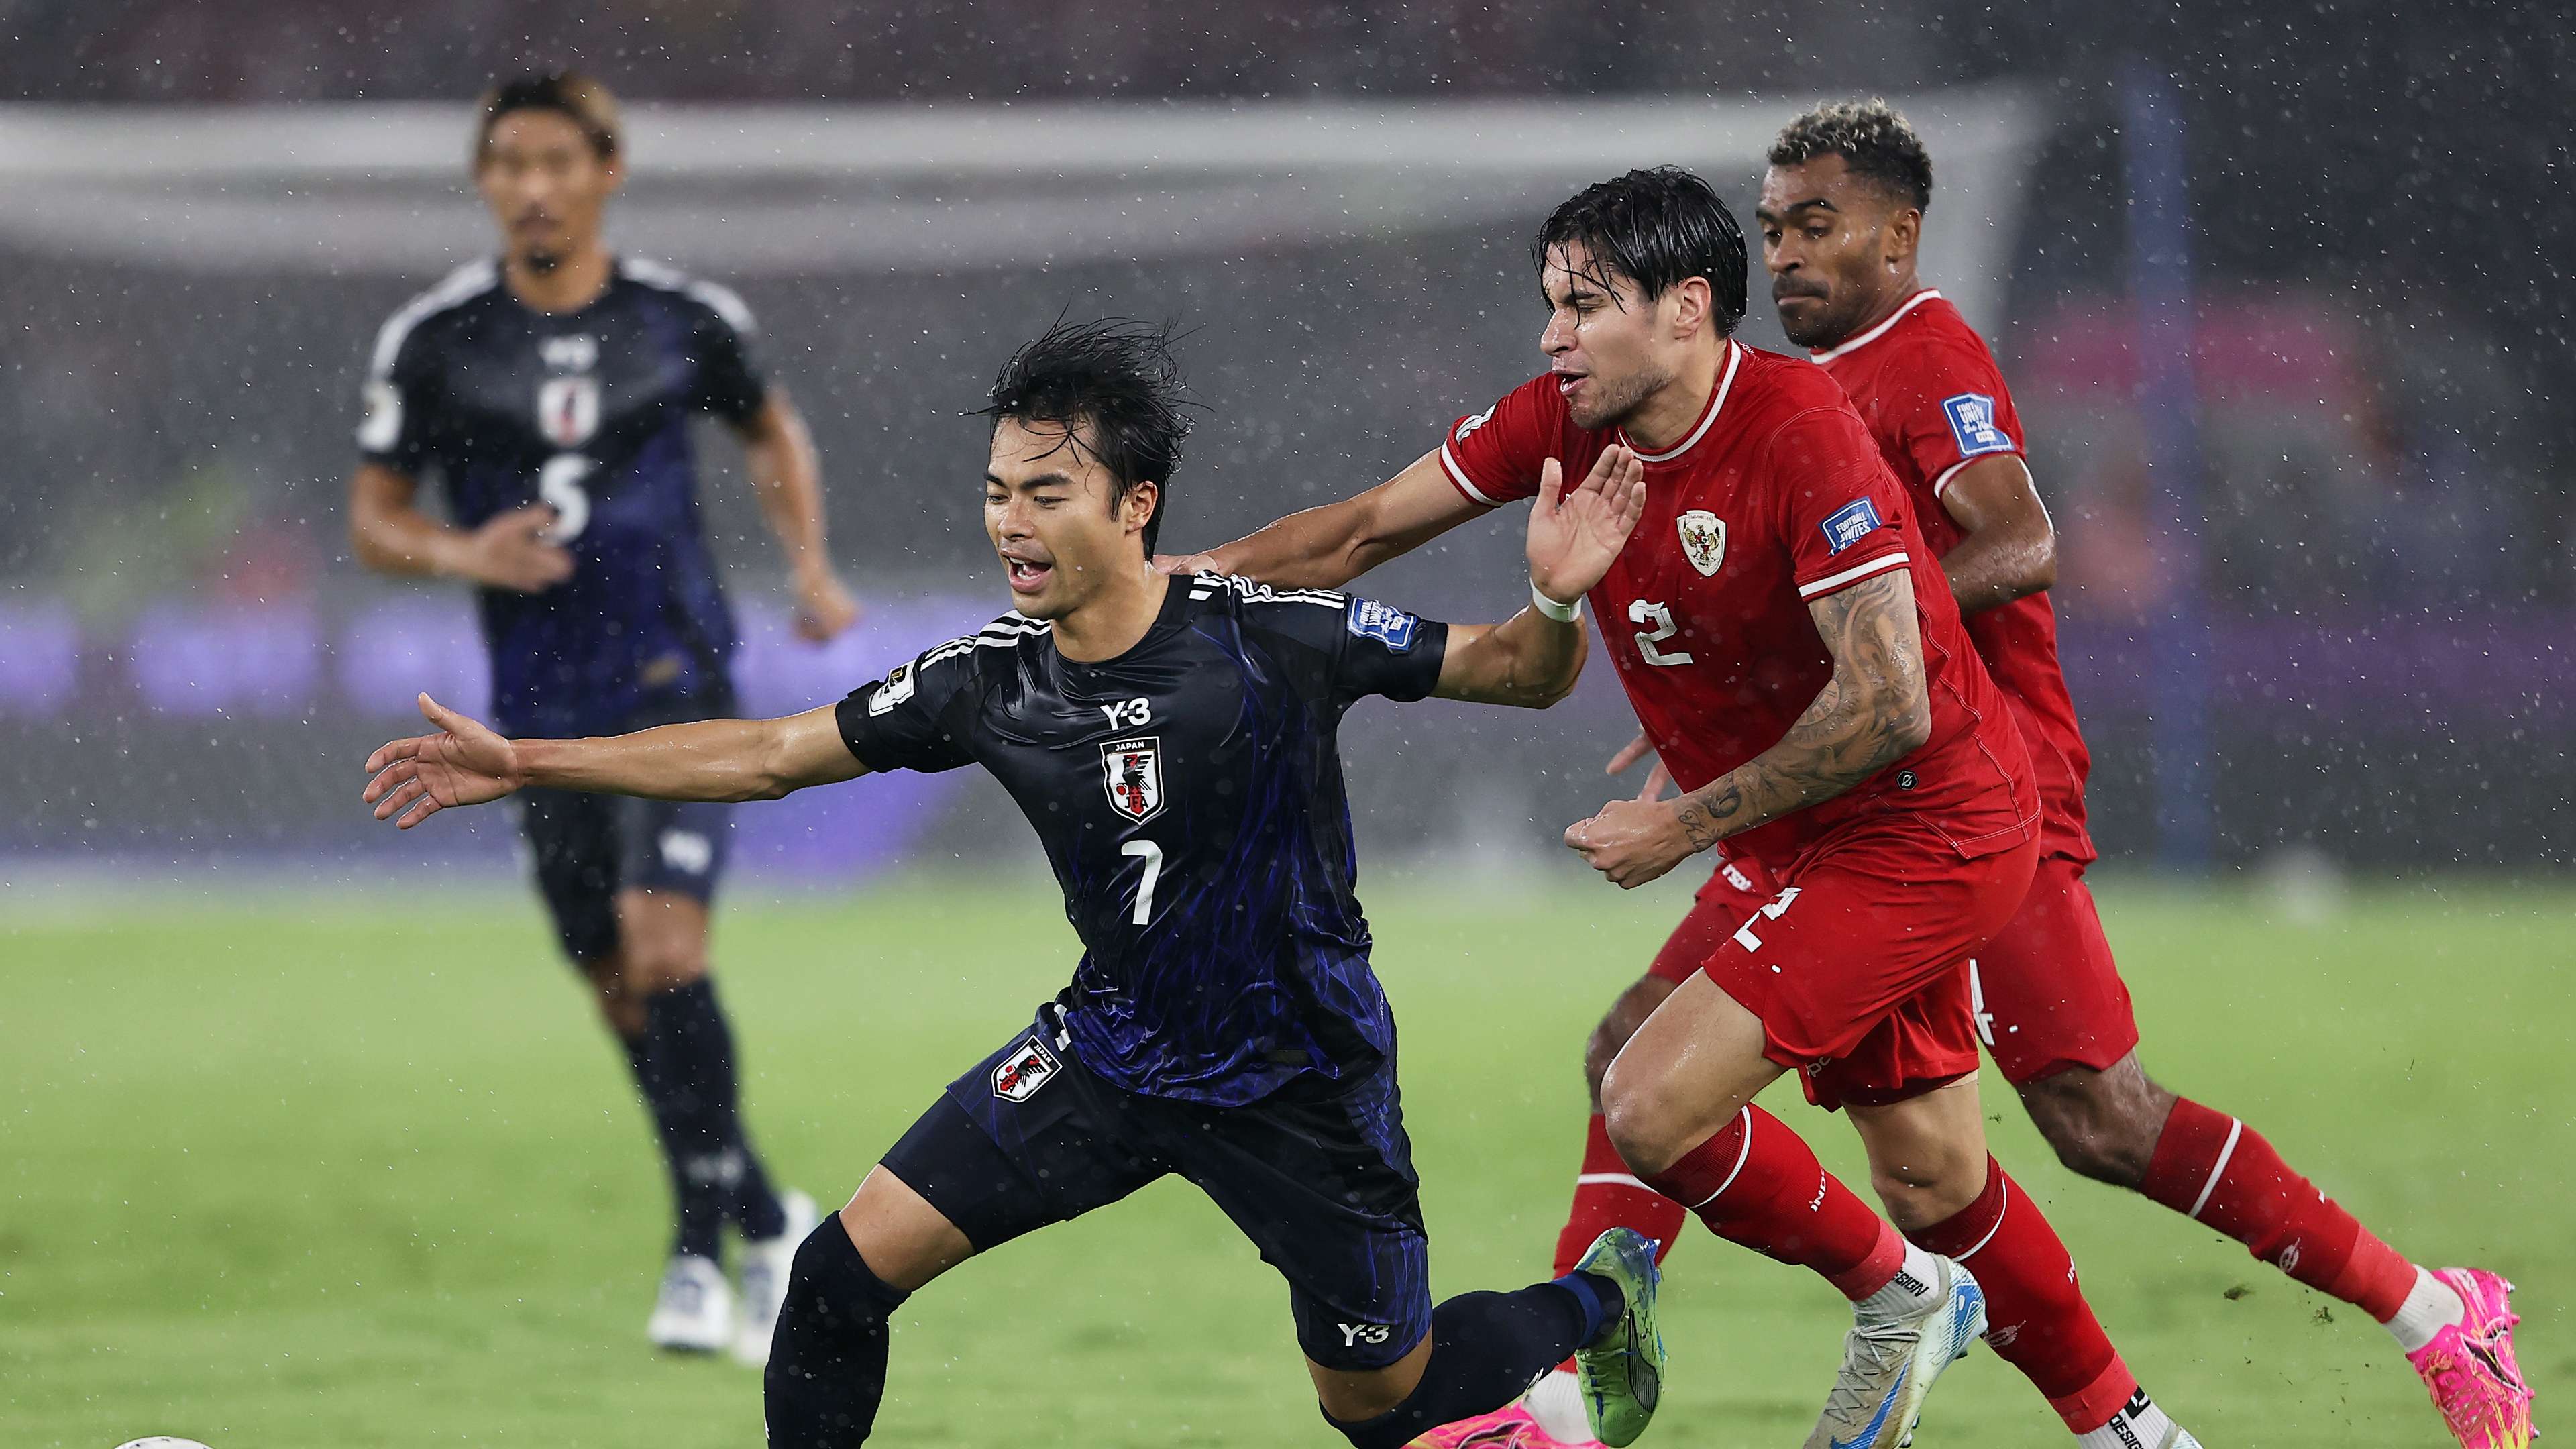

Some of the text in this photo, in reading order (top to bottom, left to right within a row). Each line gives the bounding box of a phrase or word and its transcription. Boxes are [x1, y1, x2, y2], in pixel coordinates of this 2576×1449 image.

[539, 453, 595, 544] 5
[1835, 511, 1868, 534] FOOTBALL
[1629, 599, 1693, 666] 2
[1100, 698, 1151, 730] Y-3
[1115, 741, 1144, 751] JAPAN
[1121, 840, 1163, 925] 7
[1034, 1044, 1053, 1063] JAPAN
[1893, 1267, 1929, 1297] ESIGN
[1338, 1324, 1390, 1346] Y-3
[2109, 1413, 2143, 1449] DESIG
